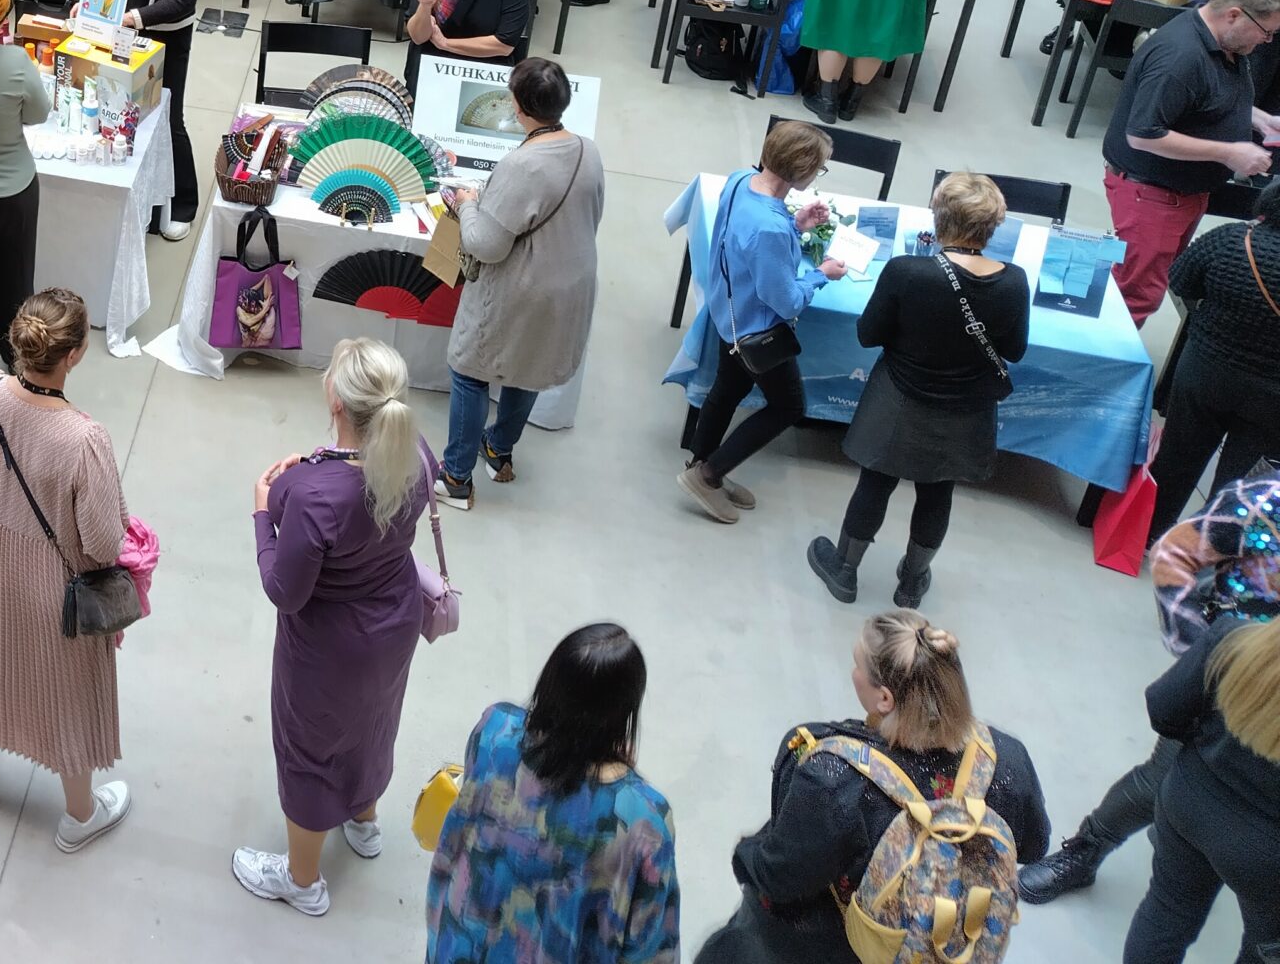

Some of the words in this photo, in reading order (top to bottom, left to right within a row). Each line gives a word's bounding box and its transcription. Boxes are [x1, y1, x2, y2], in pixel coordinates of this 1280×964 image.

[57, 55, 66, 81] YOUR
[434, 133, 464, 145] kuumiin
[467, 139, 506, 151] tilanteisiin
[473, 160, 489, 169] 050
